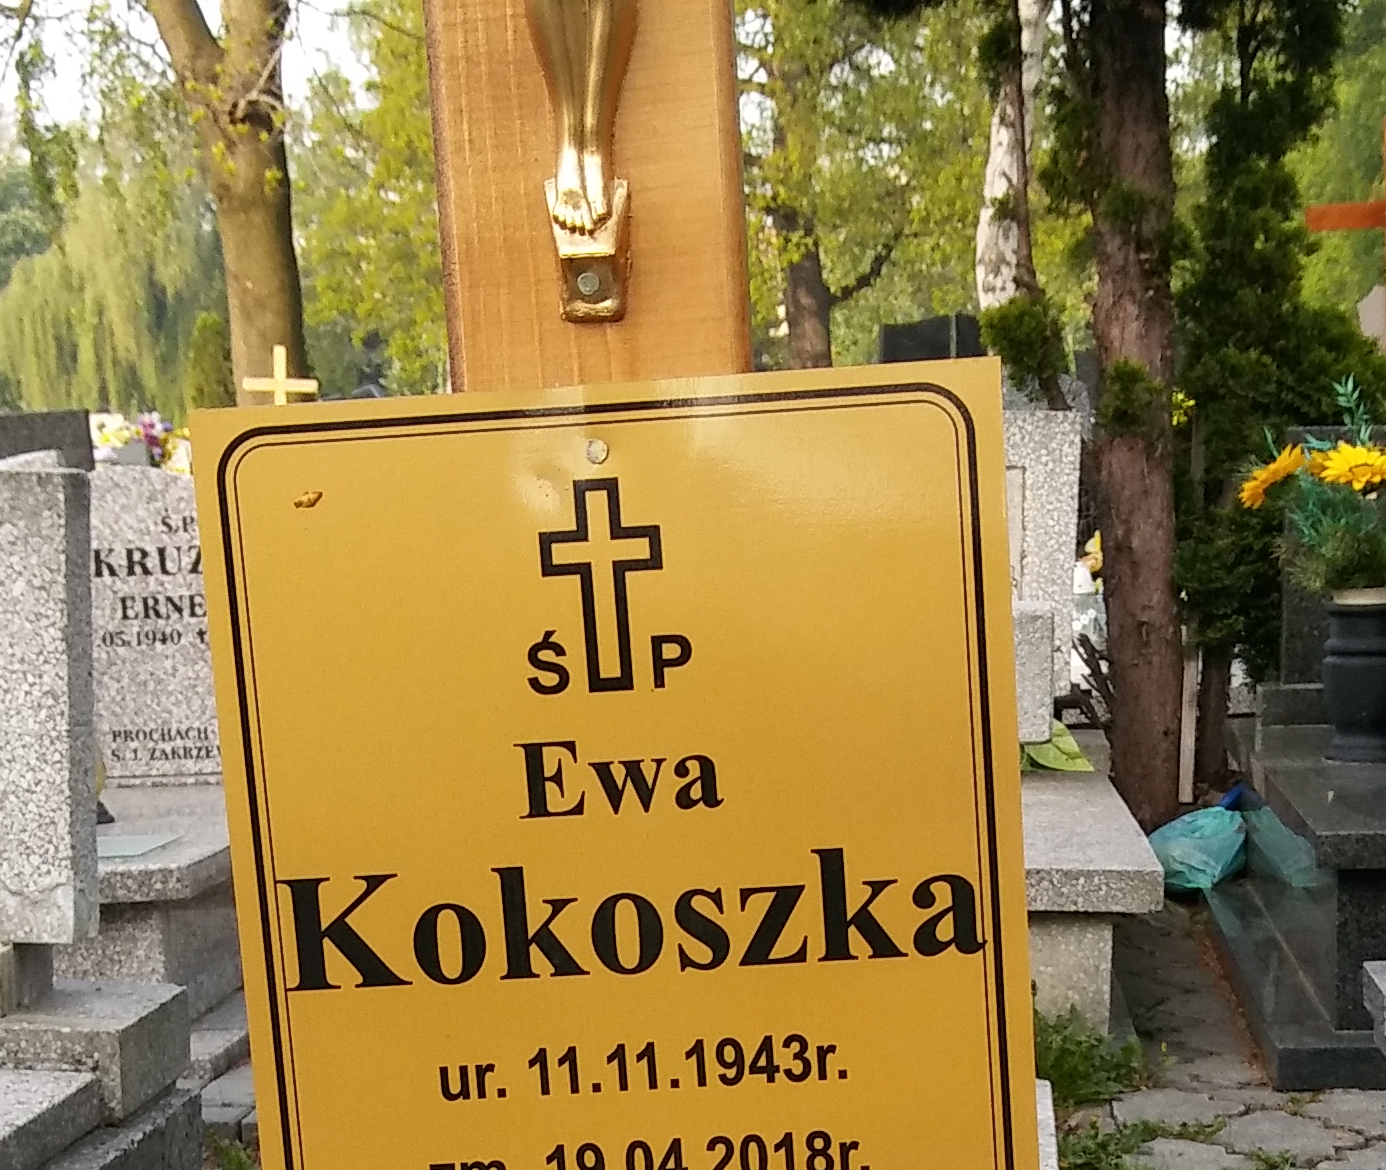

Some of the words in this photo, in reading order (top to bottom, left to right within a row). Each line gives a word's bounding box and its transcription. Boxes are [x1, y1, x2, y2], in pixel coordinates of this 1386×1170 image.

[512, 740, 725, 820] Ewa
[276, 847, 988, 993] Kokoszka
[438, 1063, 507, 1102] ur.
[527, 1033, 849, 1096] 11.11.1943r.
